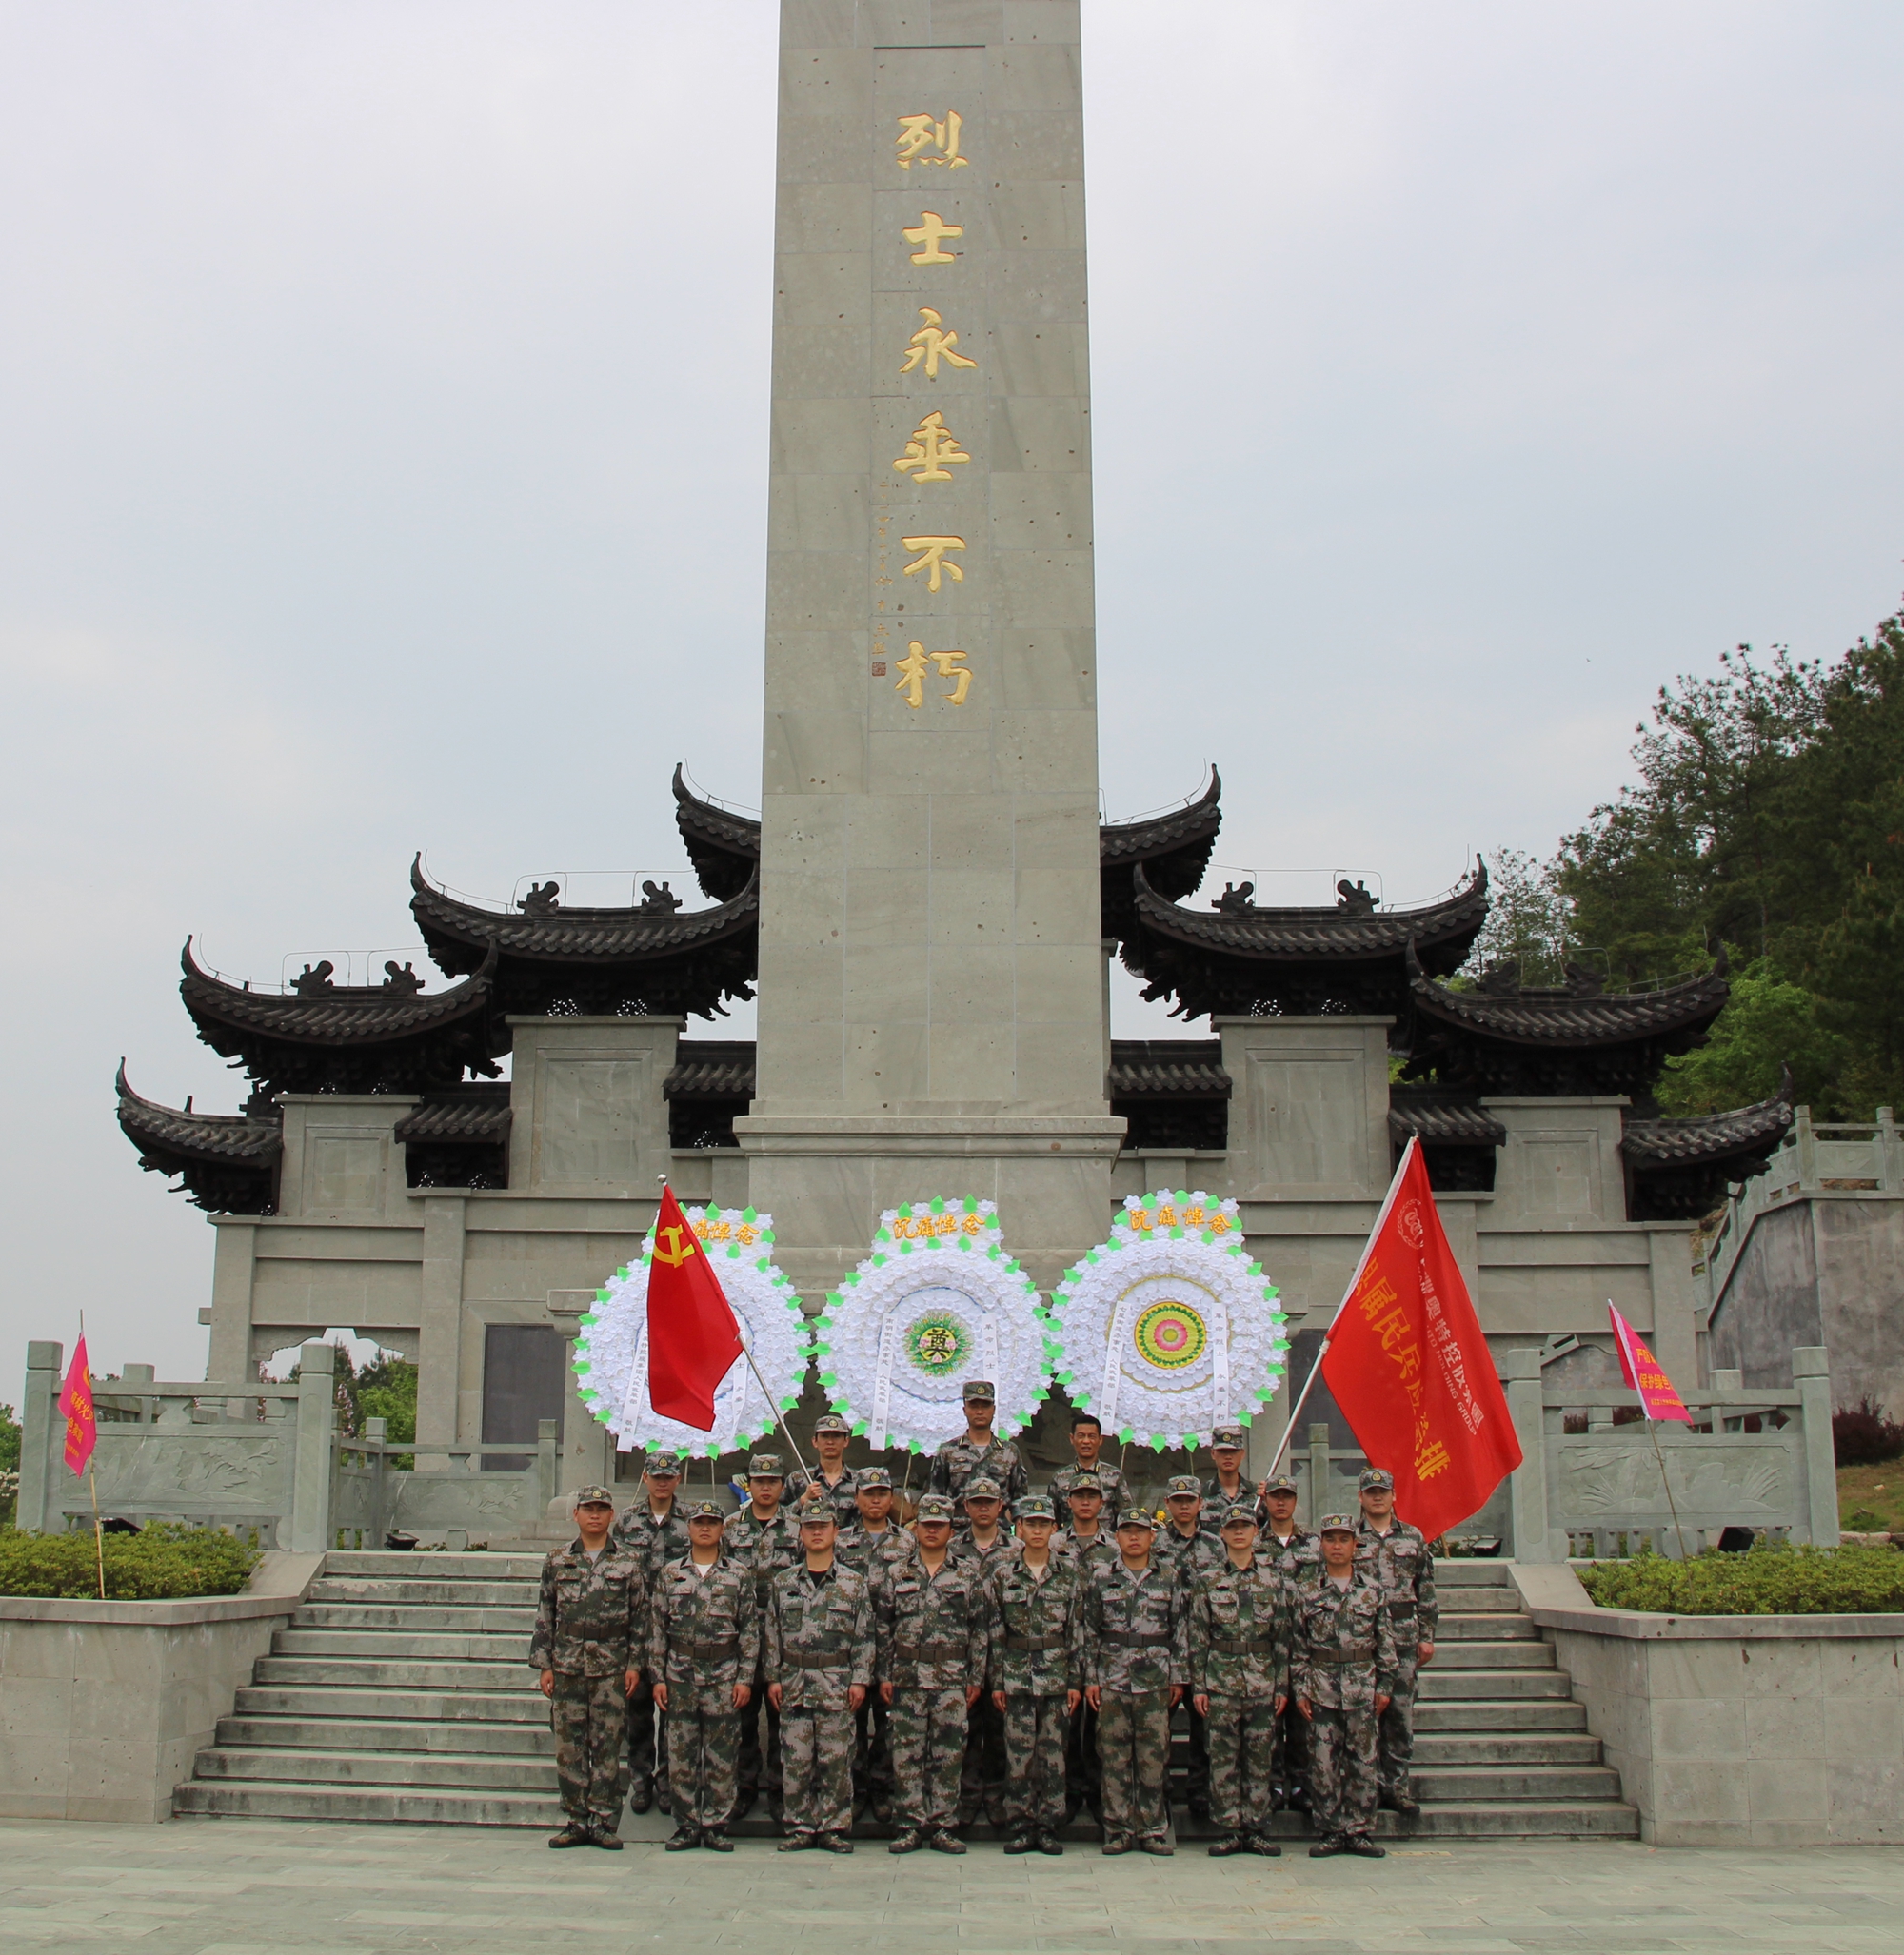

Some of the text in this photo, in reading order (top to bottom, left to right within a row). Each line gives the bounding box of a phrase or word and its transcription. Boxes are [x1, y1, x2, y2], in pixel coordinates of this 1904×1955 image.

[894, 109, 978, 710] 烈士永垂不朽
[893, 1213, 985, 1239] 沉痛悼念
[1130, 1205, 1232, 1234] 沉痛悼念
[926, 1328, 950, 1359] 奠
[1457, 1401, 1477, 1436] GROUP
